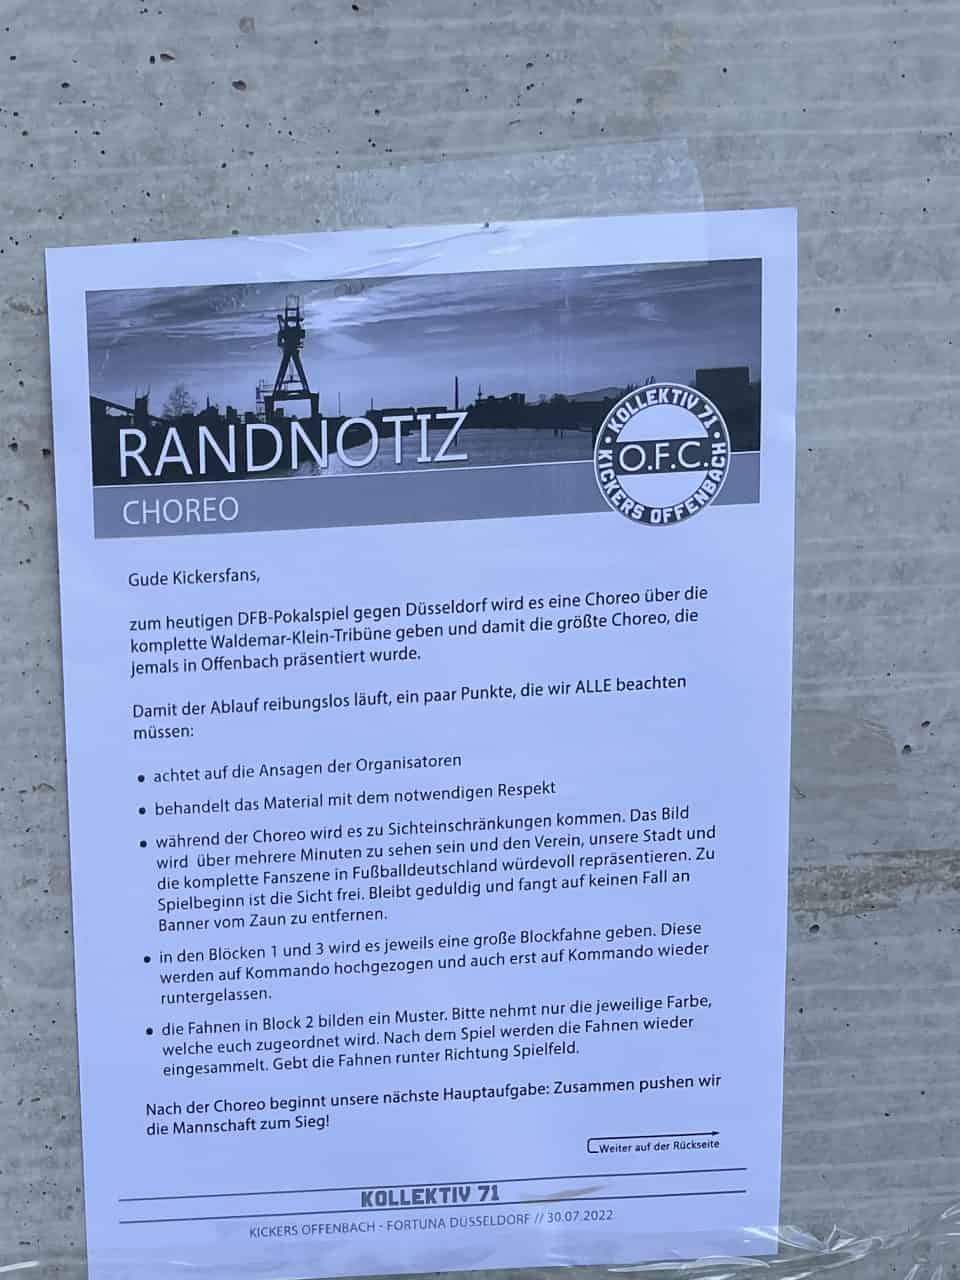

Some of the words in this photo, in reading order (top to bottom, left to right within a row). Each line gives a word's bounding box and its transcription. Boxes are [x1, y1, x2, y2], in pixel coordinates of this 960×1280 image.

[608, 388, 700, 433] KOLLEKTIV
[697, 405, 718, 429] 71
[119, 412, 468, 478] RANDNOTIZ
[619, 441, 709, 471] O.F.C.
[598, 449, 645, 519] KICKERS
[650, 442, 726, 523] OFFENBACH
[123, 497, 239, 525] CHOREO
[128, 571, 168, 586] Gude
[172, 567, 260, 584] Kickersfans,
[128, 619, 161, 631] zum
[166, 614, 233, 631] heutigen
[237, 605, 349, 625] DFB-Pokalspiel
[352, 606, 401, 623] gegen
[405, 597, 488, 616] Düsseldorf
[490, 595, 524, 611] wird
[528, 597, 544, 609] es
[548, 593, 581, 608] eine
[584, 591, 640, 606] Choreo
[644, 587, 680, 602] über
[684, 585, 708, 600] die
[130, 636, 207, 654] komplette
[210, 627, 392, 648] Waldemar-Klein-Tribüne
[395, 623, 443, 642] geben
[448, 619, 477, 636] und
[481, 618, 525, 634] damit
[529, 616, 553, 631] die
[556, 613, 608, 633] größte
[611, 611, 670, 626] Choreo,
[674, 607, 698, 623] die
[131, 658, 179, 678] jemals
[183, 658, 197, 672] in
[200, 653, 279, 671] Offenbach
[283, 650, 366, 670] präsentiert
[369, 645, 421, 662] wurde.
[132, 703, 177, 718] Damit
[181, 700, 206, 715] der
[210, 697, 260, 714] Ablauf
[263, 693, 350, 712] reibungslos
[354, 690, 392, 706] läuft,
[396, 689, 419, 704] ein
[423, 690, 457, 706] paar
[460, 684, 516, 700] Punkte,
[520, 682, 543, 696] die
[547, 681, 571, 695] wir
[575, 678, 612, 694] ALLE
[616, 675, 686, 691] beachten
[133, 725, 194, 739] müssen:
[154, 798, 230, 815] behandelt
[234, 797, 259, 811] das
[263, 793, 323, 809] Material
[328, 792, 352, 806] mit
[356, 790, 389, 804] dem
[394, 785, 493, 802] notwendigen
[497, 780, 556, 798] Respekt
[146, 1101, 182, 1116] Nach
[185, 1100, 210, 1114] der
[213, 1099, 266, 1112] Choreo
[269, 1095, 327, 1112] beginnt
[330, 1094, 379, 1106] unsere
[383, 1089, 439, 1103] nächste
[443, 1082, 550, 1101] Hauptaufgabe:
[552, 1080, 635, 1094] Zusammen
[639, 1075, 694, 1093] pushen
[698, 1073, 722, 1087] wir
[146, 1122, 169, 1135] die
[170, 1117, 256, 1134] Mannschaft
[259, 1119, 291, 1130] zum
[294, 1114, 329, 1130] Sieg!
[599, 1144, 632, 1153] Weiter
[635, 1142, 651, 1152] auf
[654, 1141, 670, 1150] der
[673, 1140, 720, 1150] Rückseite
[361, 1186, 471, 1207] KOLLEKTIV
[478, 1184, 500, 1201] 71
[249, 1223, 299, 1239] KICKERS
[301, 1221, 376, 1236] OFFENBACH
[387, 1218, 446, 1232] FORTUNA
